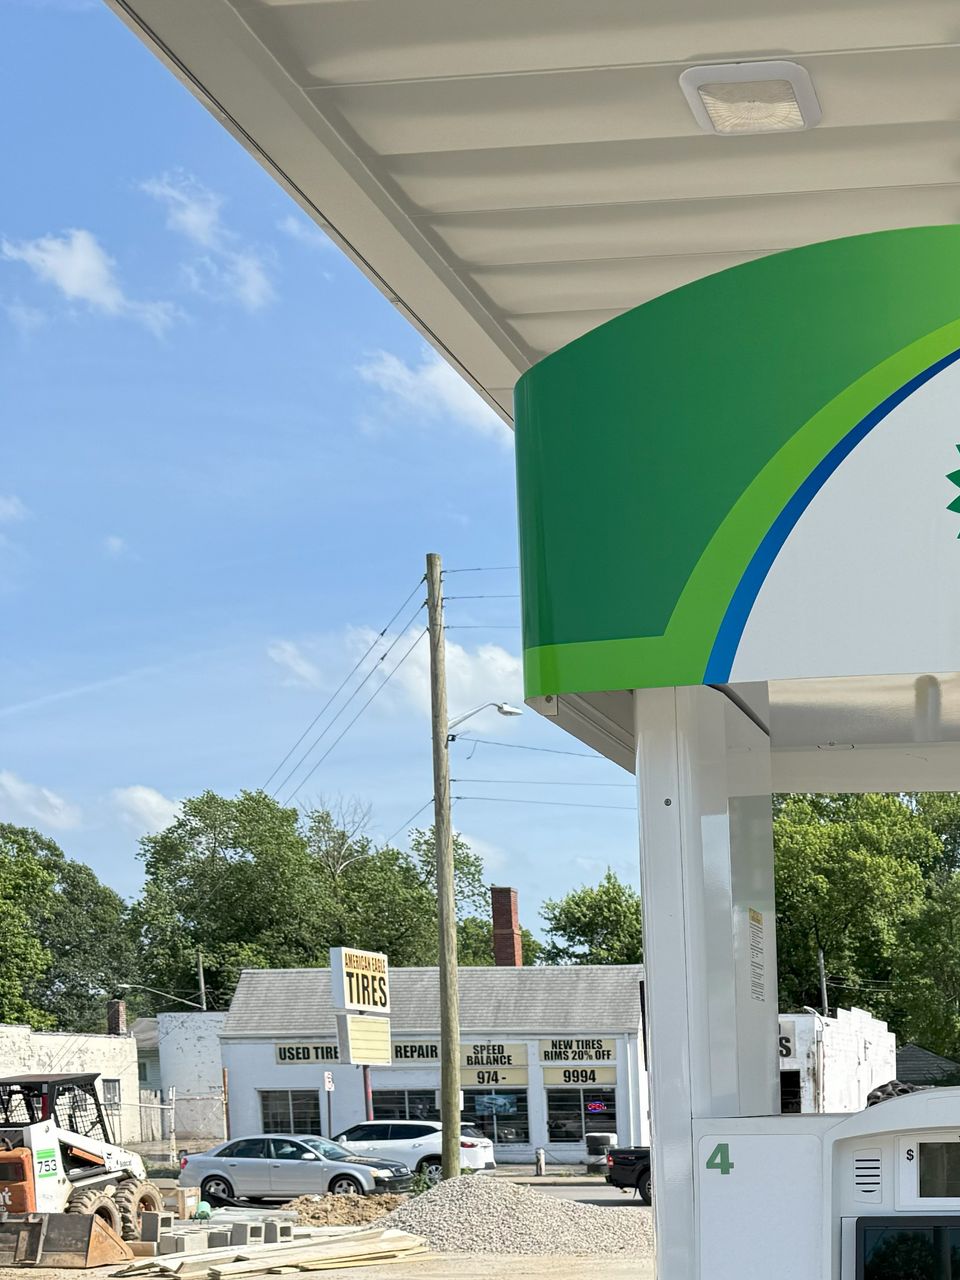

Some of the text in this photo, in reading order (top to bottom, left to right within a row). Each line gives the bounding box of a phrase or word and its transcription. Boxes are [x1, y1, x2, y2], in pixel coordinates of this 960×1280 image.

[346, 971, 387, 1007] TIRES
[473, 1044, 504, 1055] SPEED
[551, 1039, 603, 1050] NEW TIRES
[279, 1046, 339, 1060] USED TIRE
[395, 1045, 438, 1059] REPAIR
[544, 1050, 612, 1061] RIMS 20% OFF
[466, 1055, 512, 1066] BALANCE
[477, 1071, 499, 1084] 974
[563, 1070, 596, 1083] 9994
[705, 1143, 735, 1175] 4
[906, 1149, 915, 1162] $
[37, 1159, 57, 1173] 753
